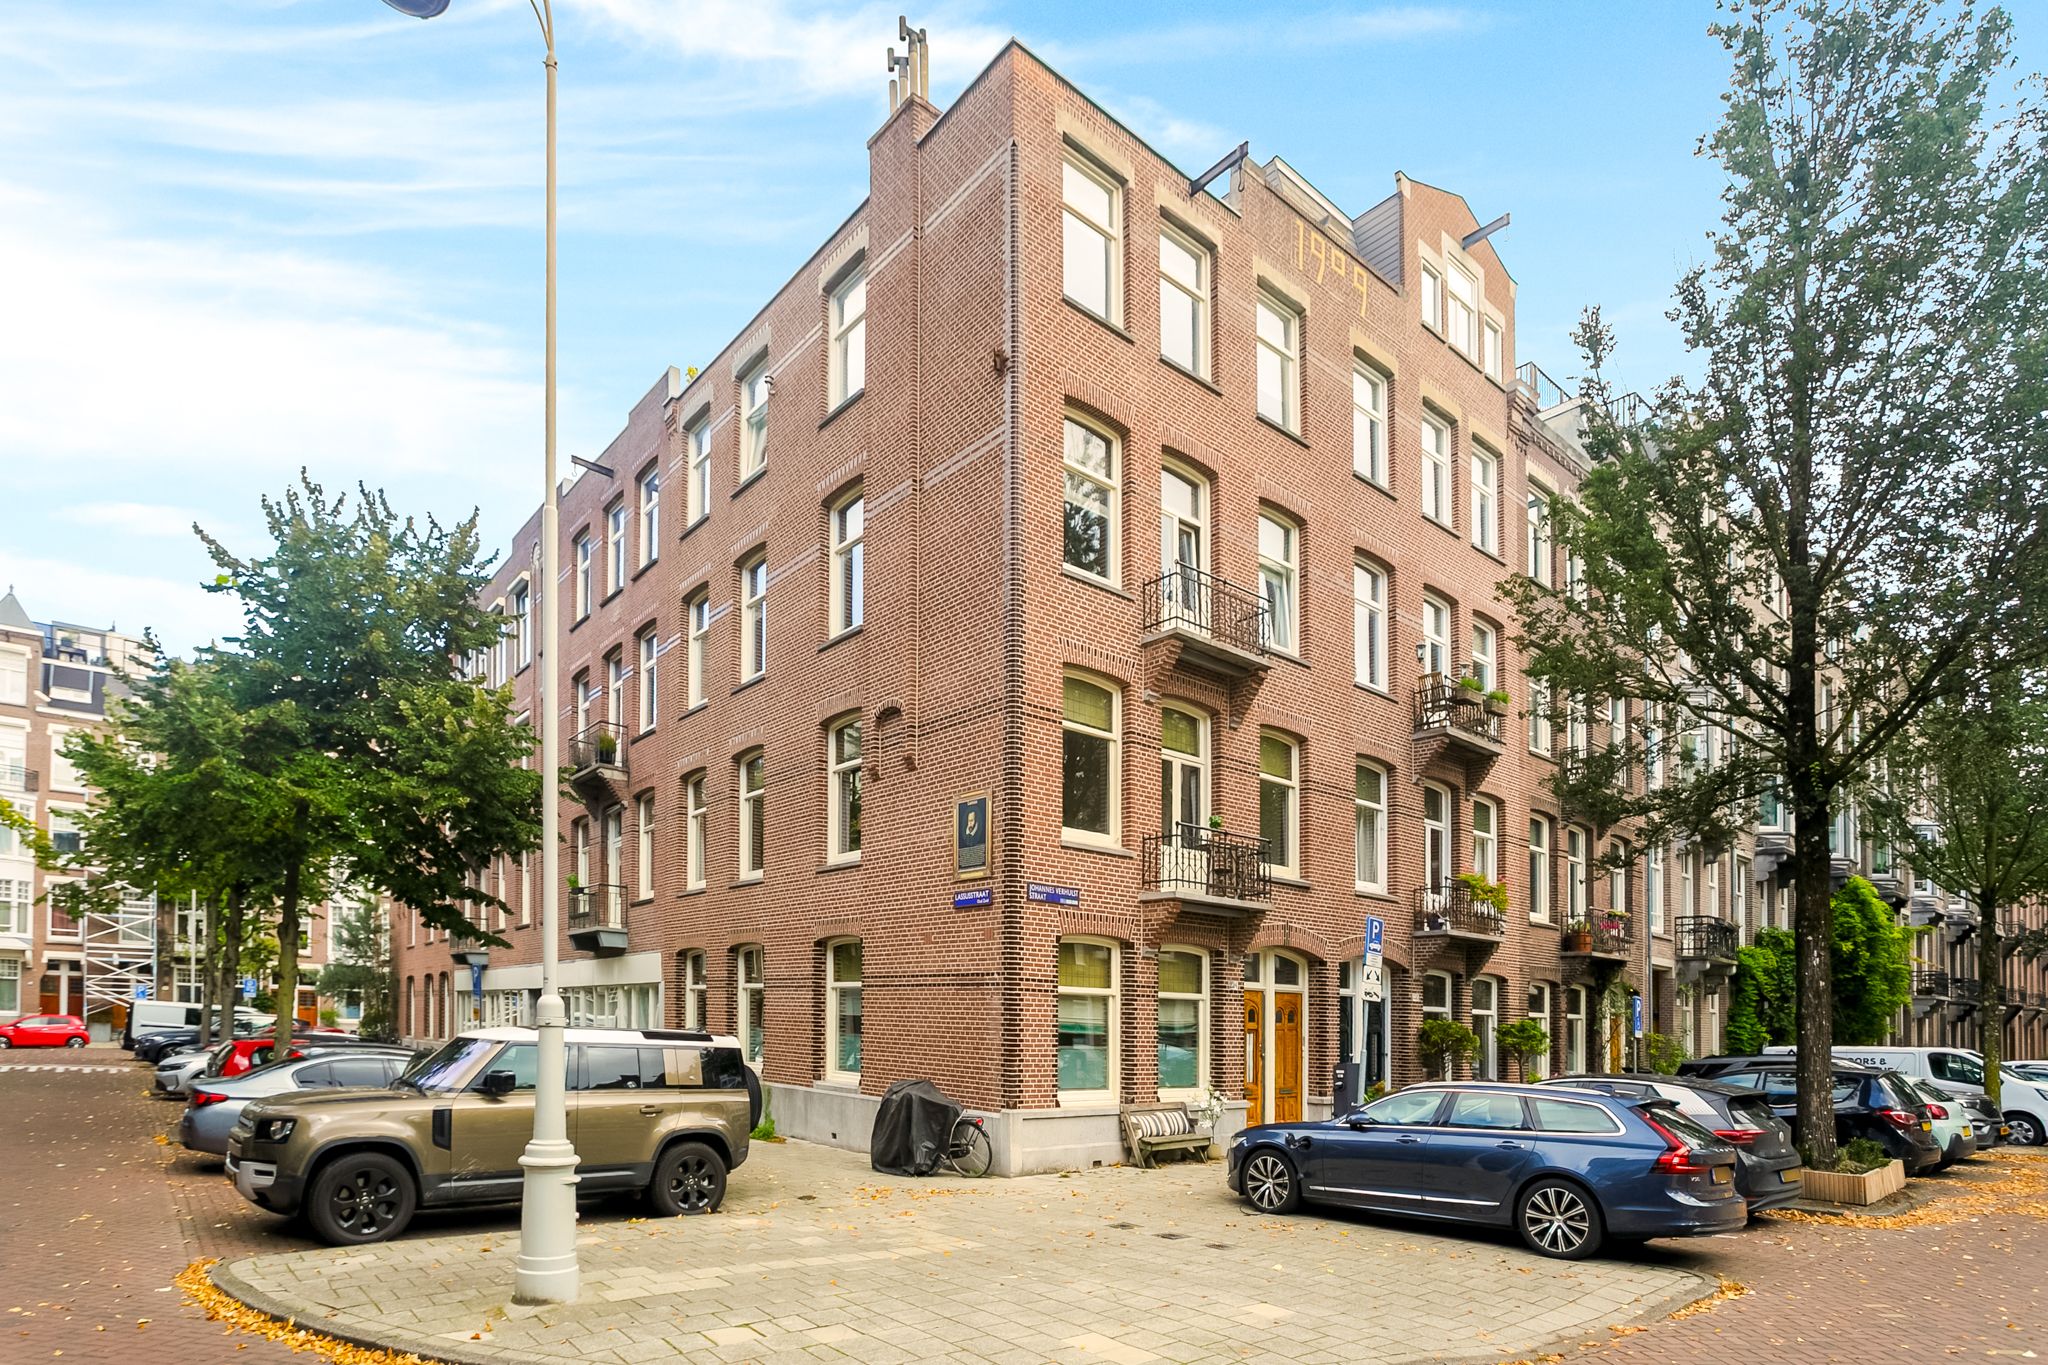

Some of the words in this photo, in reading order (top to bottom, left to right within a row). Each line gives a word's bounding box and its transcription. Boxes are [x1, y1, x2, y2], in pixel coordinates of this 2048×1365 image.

[1295, 218, 1367, 317] 1909
[955, 890, 989, 901] LASSUSSTRAAT
[1029, 883, 1055, 894] JOHANNES
[1055, 887, 1079, 897] VERHULST
[1029, 892, 1047, 900] STRAAT
[1372, 921, 1380, 939] P
[1636, 1000, 1641, 1017] P
